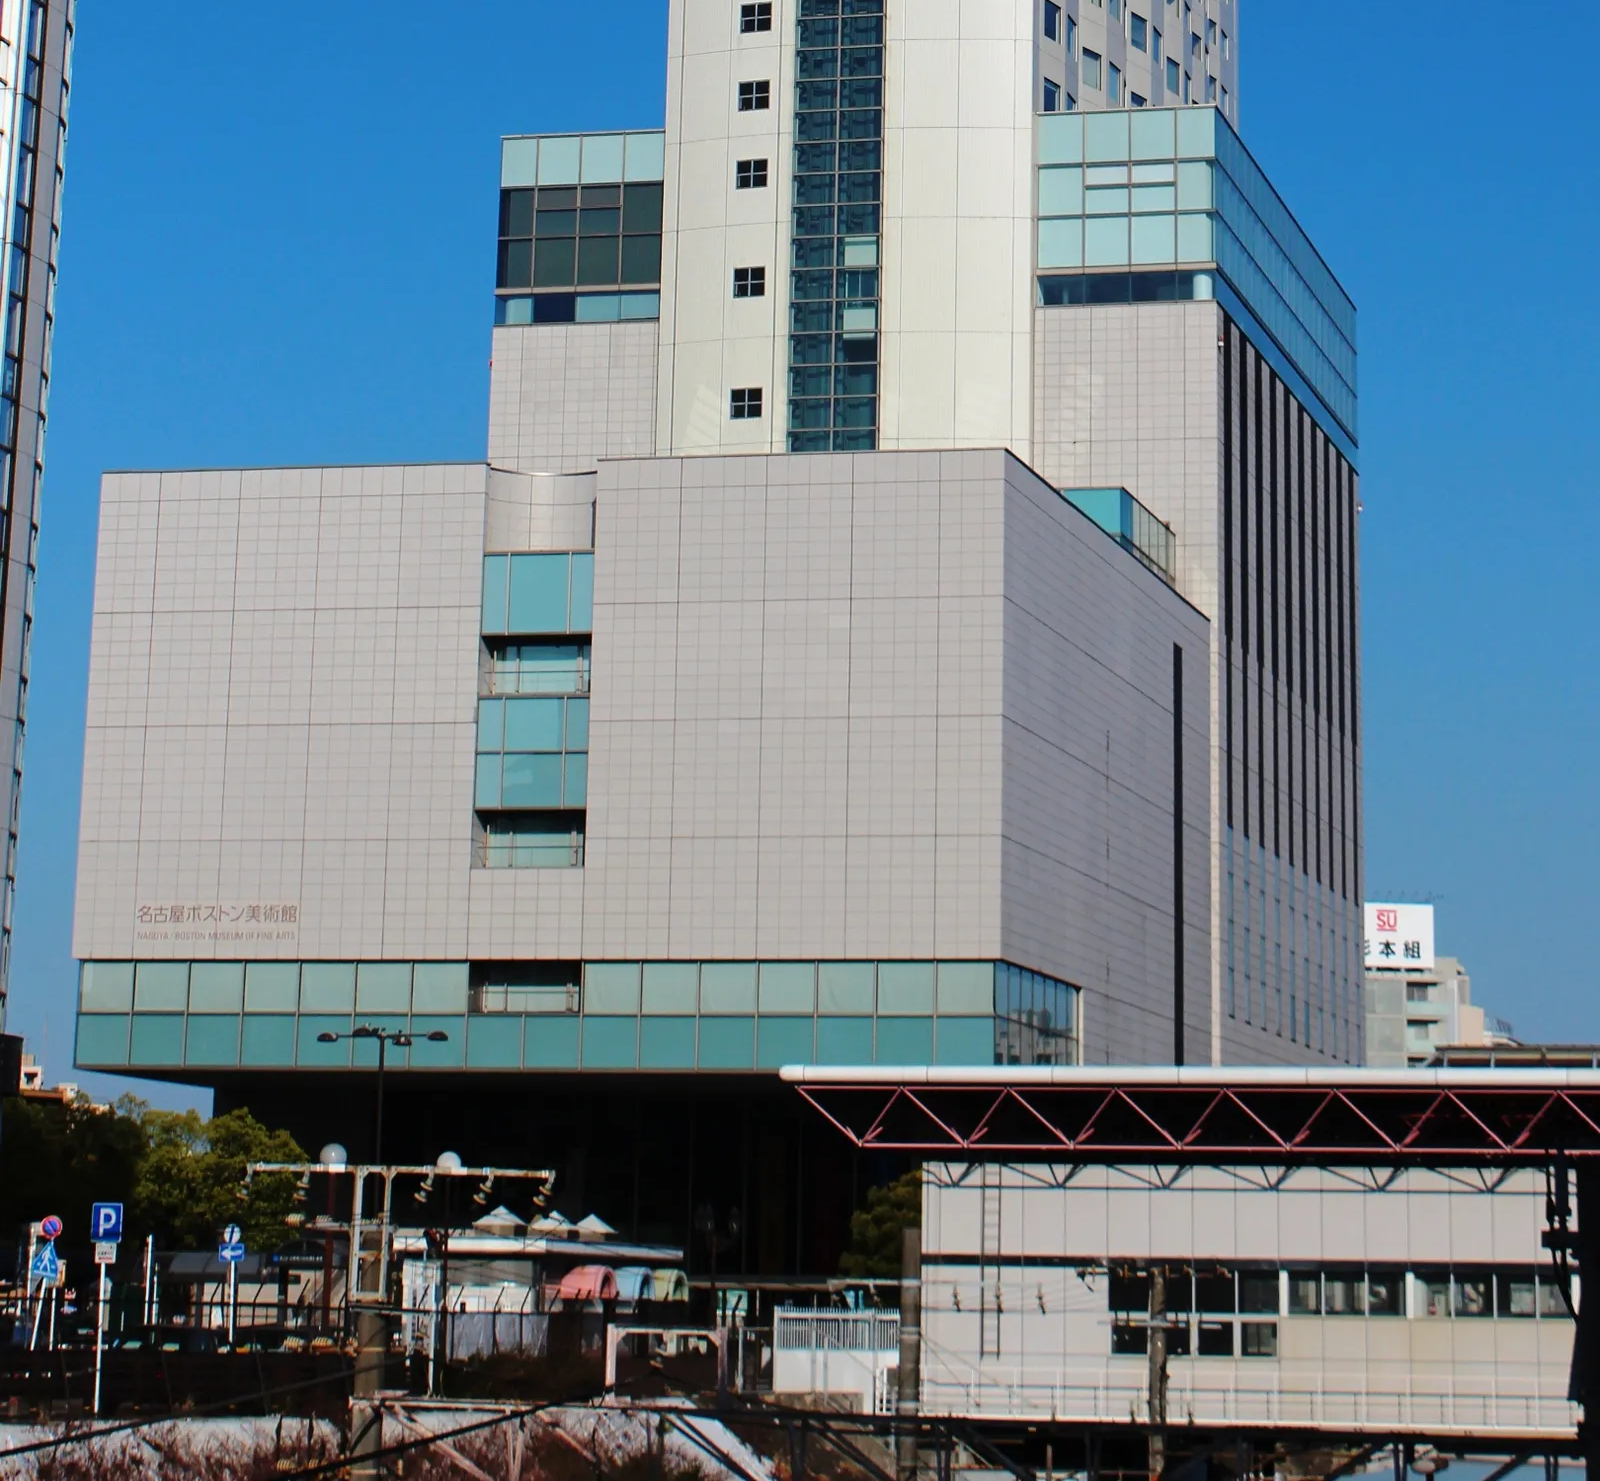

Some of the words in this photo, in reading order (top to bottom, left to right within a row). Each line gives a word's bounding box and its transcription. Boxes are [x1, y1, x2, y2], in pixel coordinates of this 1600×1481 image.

[137, 904, 298, 923] 名古屋ボストン美術館
[1376, 911, 1397, 929] SU
[208, 931, 244, 940] MUSEUM
[99, 1207, 116, 1237] P
